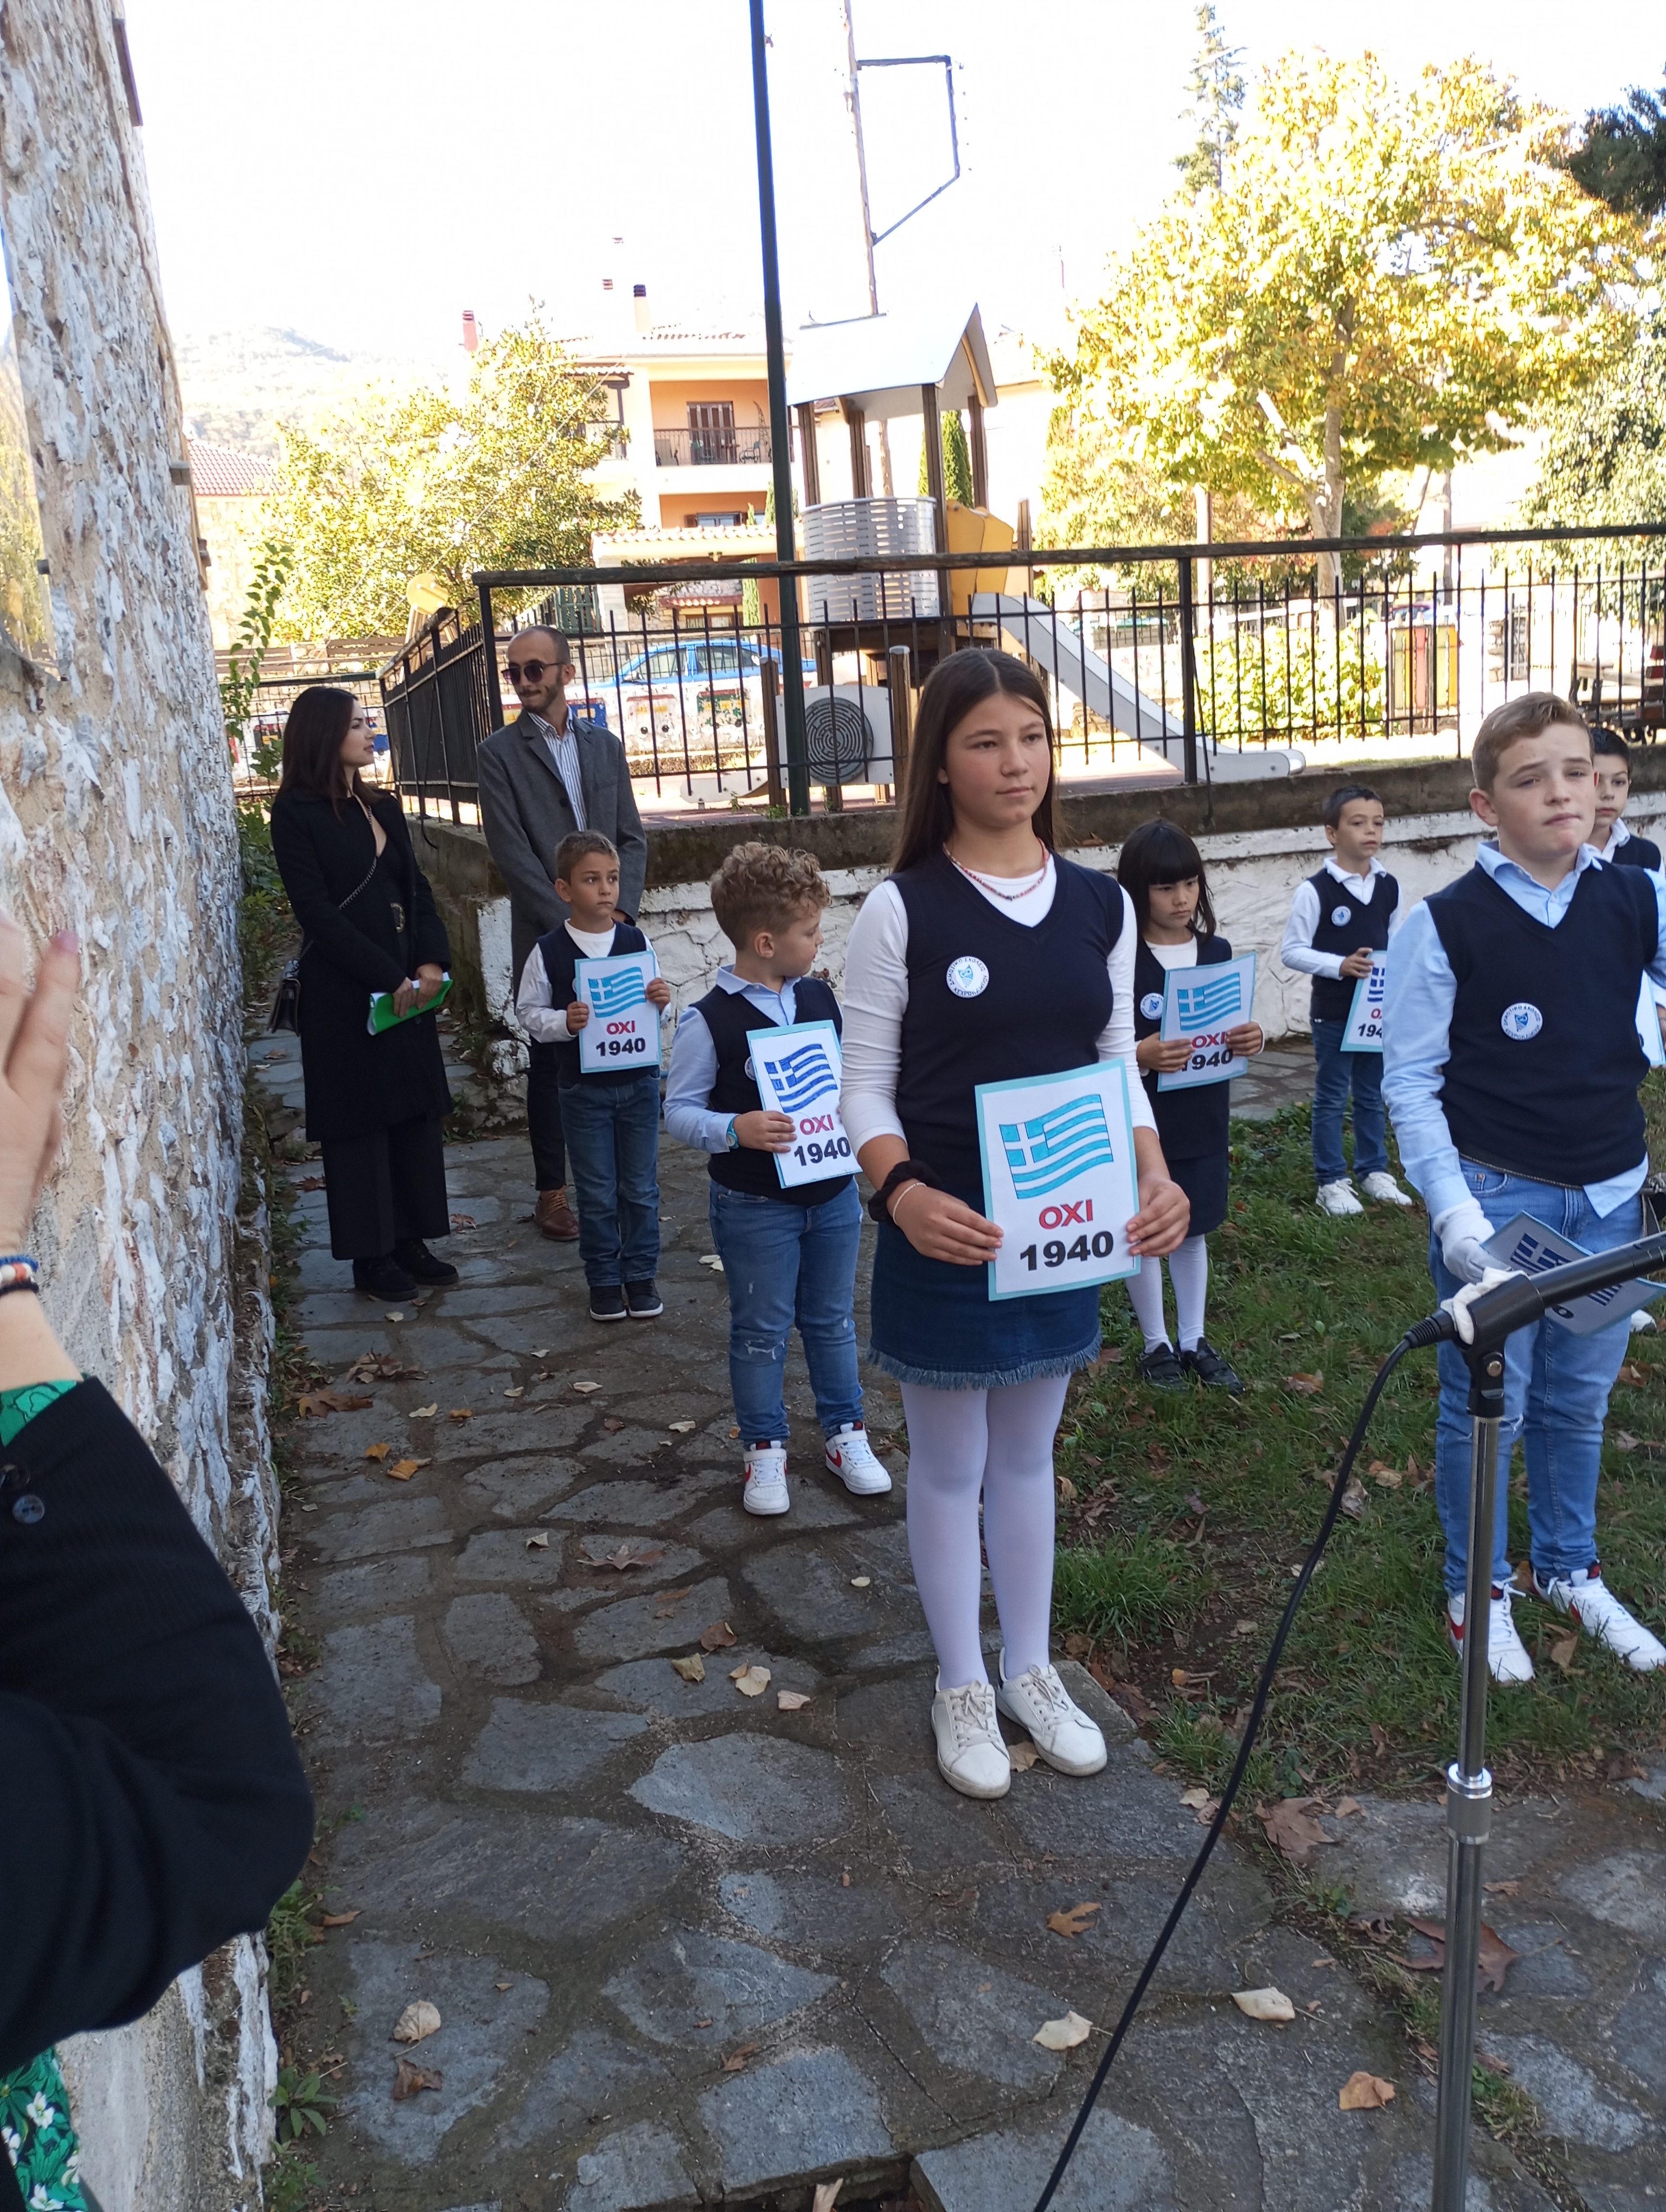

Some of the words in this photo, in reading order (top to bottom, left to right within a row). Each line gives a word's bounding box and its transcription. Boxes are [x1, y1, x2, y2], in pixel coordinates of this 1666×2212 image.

[606, 1020, 636, 1035] ΟΧΙ
[1358, 1023, 1382, 1038] 194
[595, 1037, 646, 1057] 1940
[1192, 1031, 1226, 1049] ΟΧΙ
[799, 1114, 834, 1135] ΟΧΙ
[794, 1136, 851, 1166] 1940
[1039, 1199, 1093, 1229] ΟΧΙ
[1020, 1231, 1114, 1271] 1940
